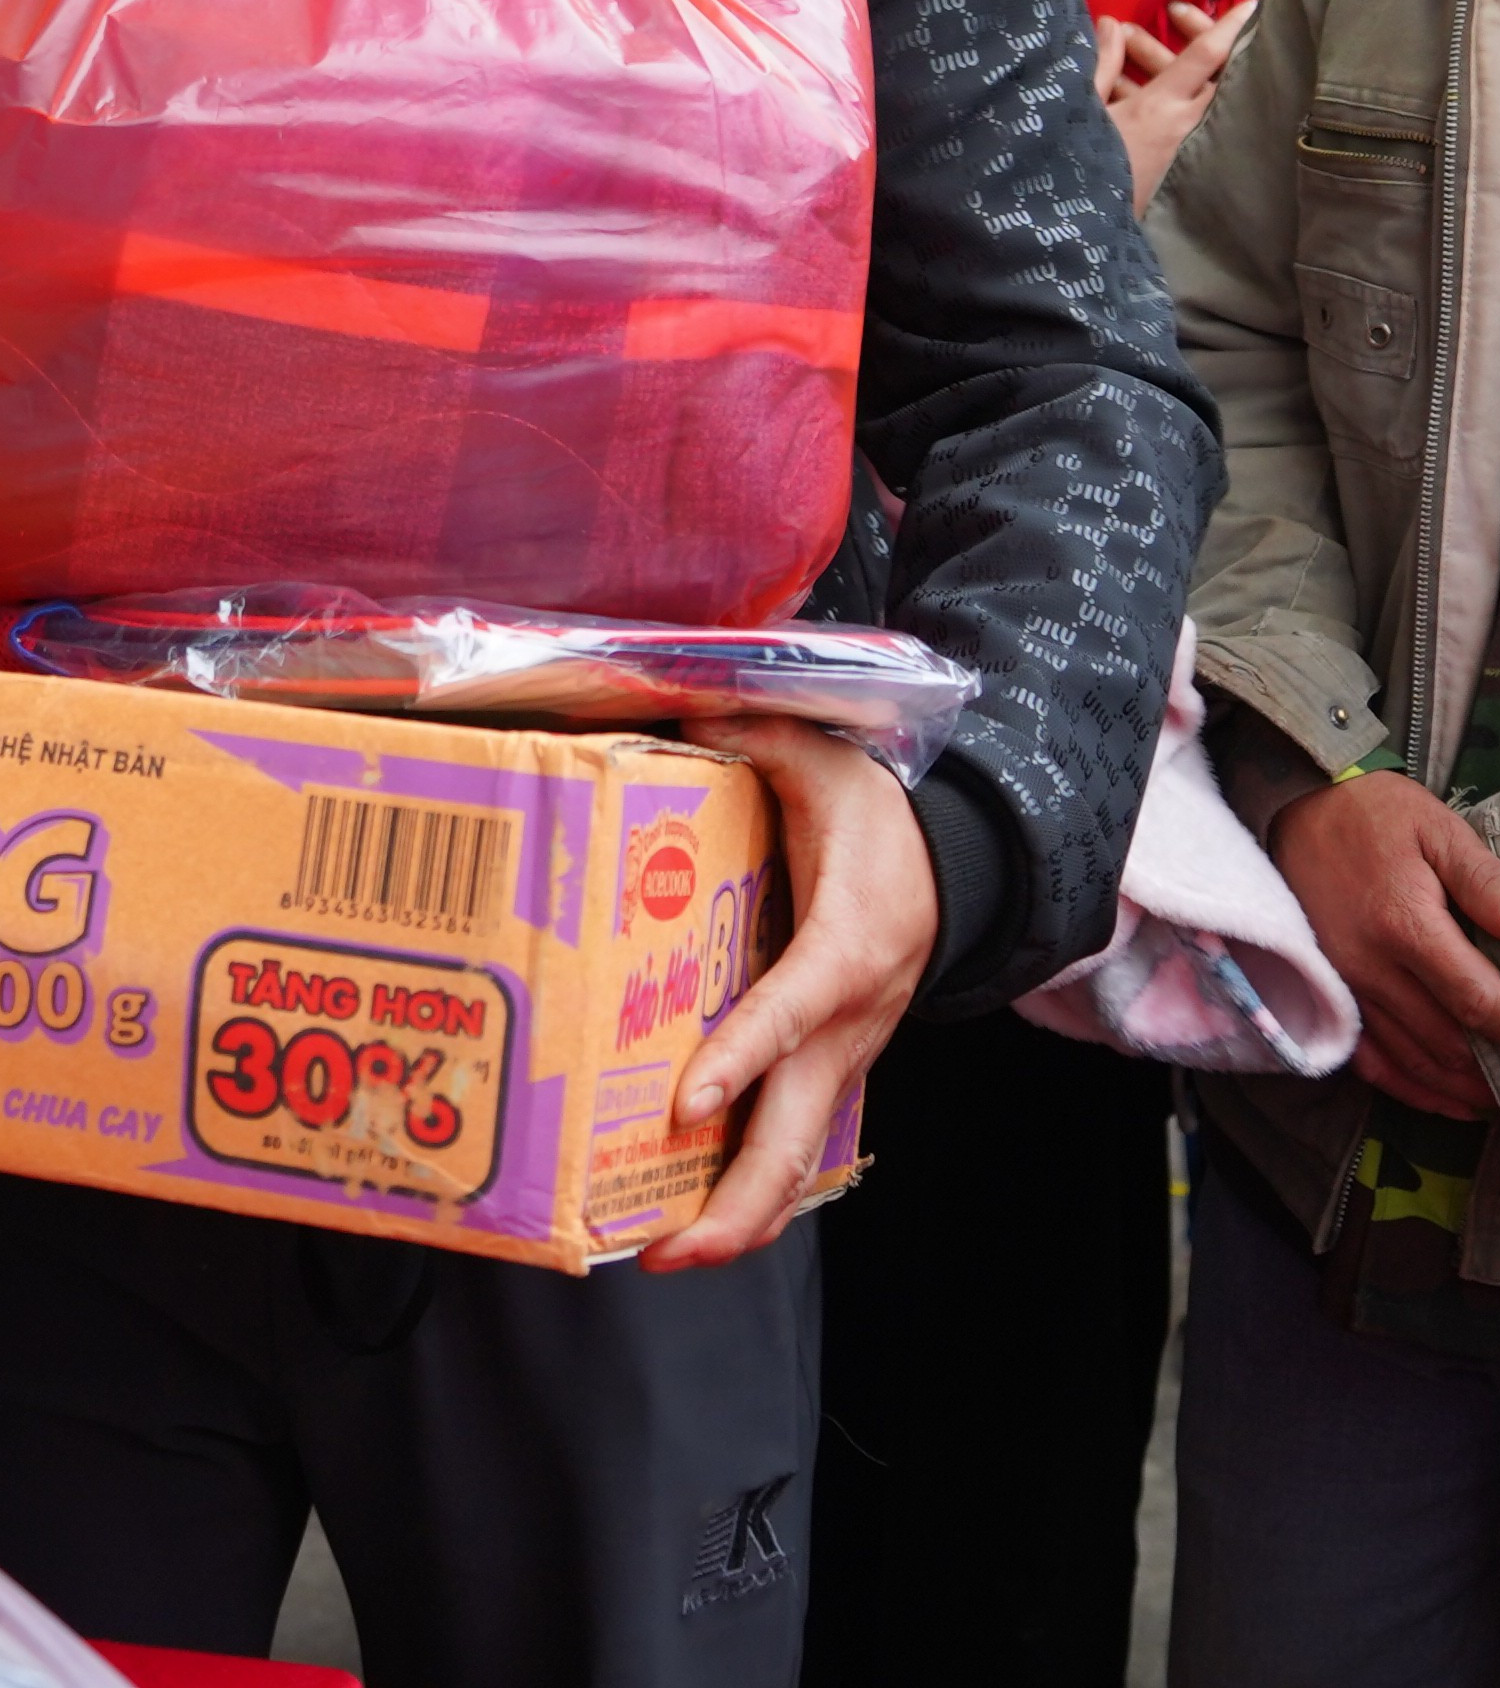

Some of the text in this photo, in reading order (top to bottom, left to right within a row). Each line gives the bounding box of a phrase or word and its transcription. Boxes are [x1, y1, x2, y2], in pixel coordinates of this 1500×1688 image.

[40, 739, 107, 774] NHẬT
[112, 745, 166, 779] BẢN
[108, 989, 149, 1046] g
[228, 959, 487, 1039] TĂNG HƠN
[206, 1016, 462, 1150] 30%
[3, 1087, 90, 1132] CHUA
[99, 1105, 164, 1143] CAY
